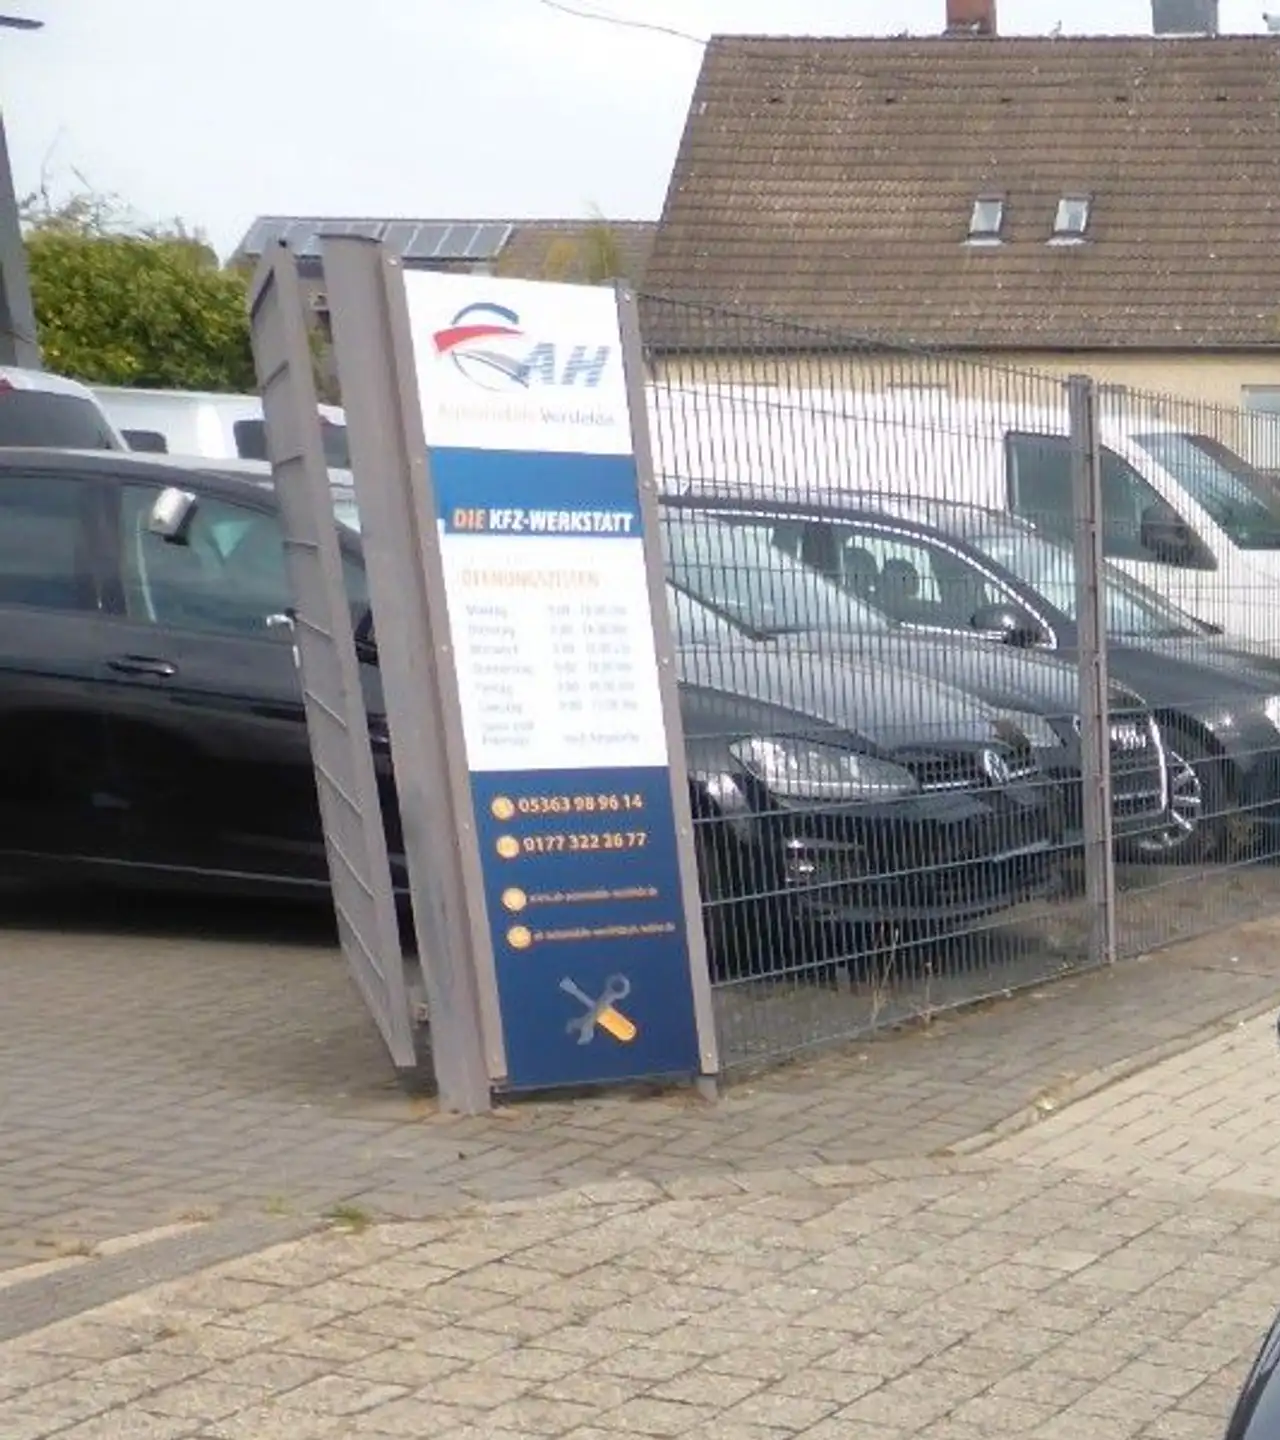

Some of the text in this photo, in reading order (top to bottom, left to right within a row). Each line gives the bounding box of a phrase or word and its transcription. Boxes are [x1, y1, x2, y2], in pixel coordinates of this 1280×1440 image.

[517, 342, 611, 388] AH
[453, 508, 634, 533] DIE KFZ-WERKSTATT
[518, 794, 643, 813] 05363 98 96 14
[523, 835, 565, 851] 0177
[569, 834, 600, 849] 322
[627, 832, 647, 847] 77
